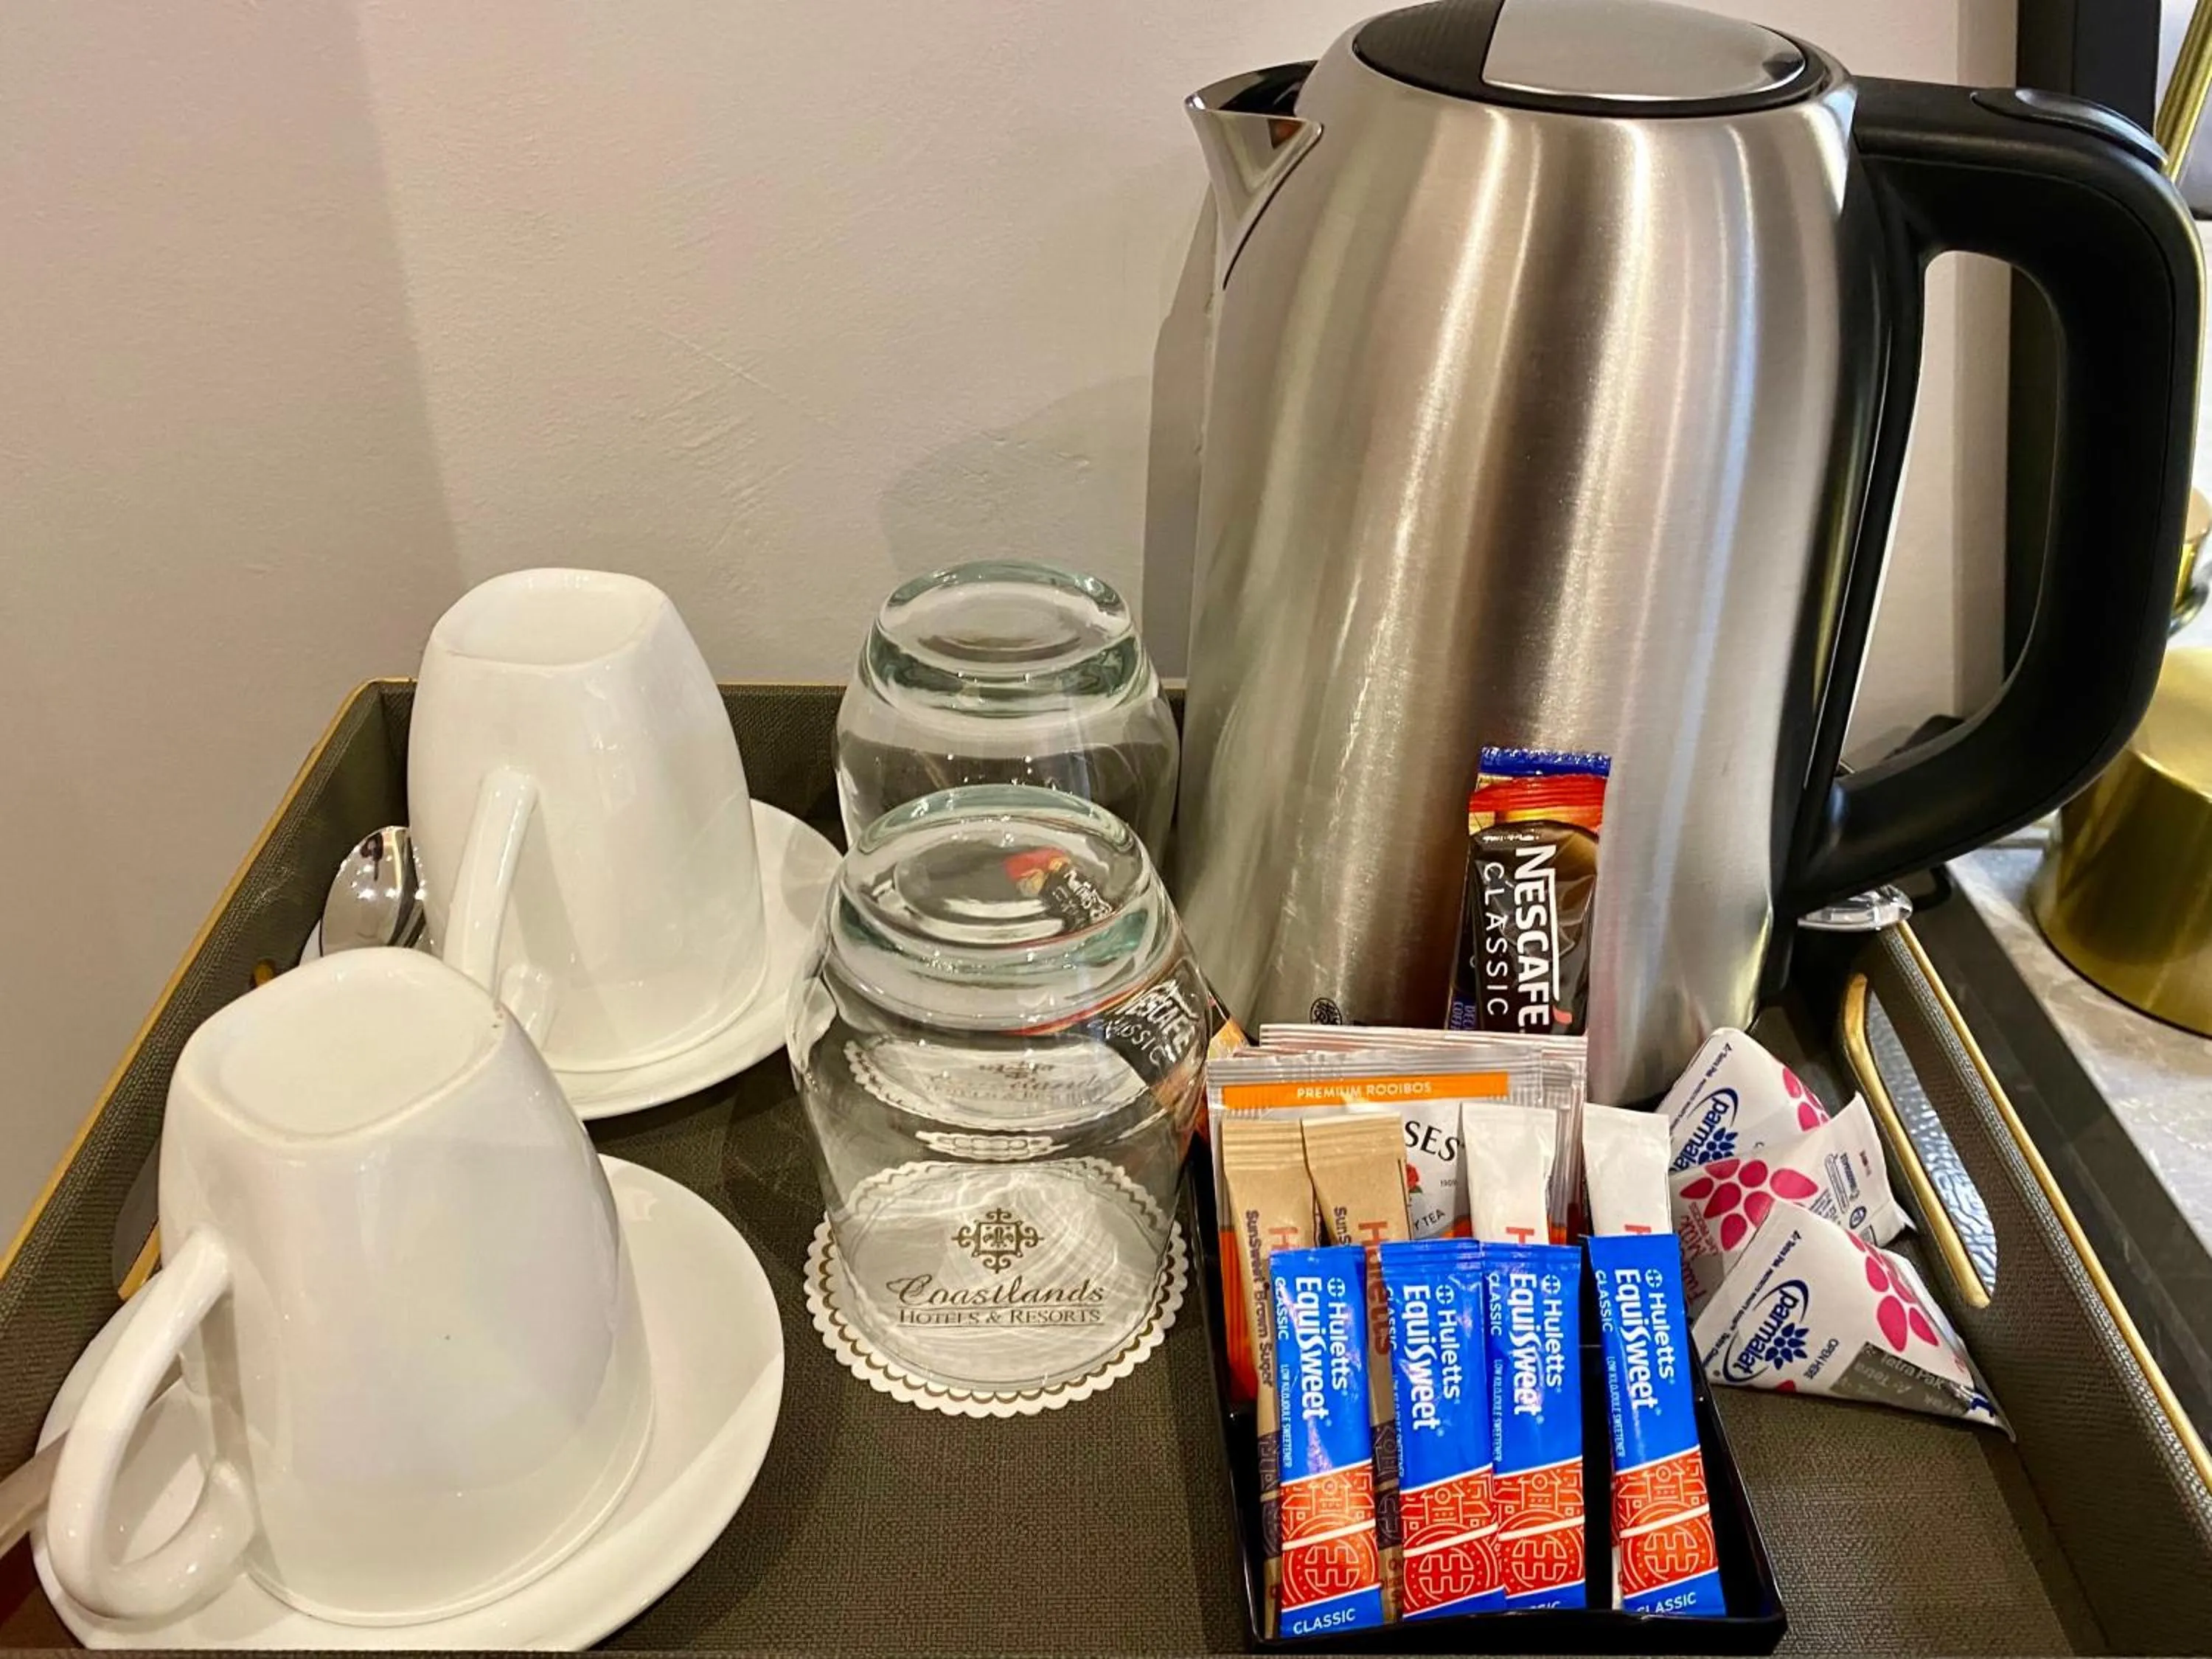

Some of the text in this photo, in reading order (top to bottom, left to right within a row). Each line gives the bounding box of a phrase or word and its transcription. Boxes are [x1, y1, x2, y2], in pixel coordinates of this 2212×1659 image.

[1484, 861, 1509, 1016] CLASSIC
[1297, 1082, 1432, 1099] PREMIUM ROOIBOS
[1405, 1120, 1461, 1162] SES
[1334, 1206, 1352, 1245] SunS
[1422, 1208, 1446, 1226] TEA
[886, 1274, 1104, 1305] Coastlands
[987, 1312, 1001, 1324] &
[1010, 1309, 1101, 1324] RESORTS
[1254, 1290, 1269, 1338] Brown
[1275, 1278, 1289, 1340] CLASSIC
[1487, 1273, 1502, 1336] CLASSIC
[1595, 1270, 1613, 1332] CLASSIC
[1295, 1276, 1328, 1421] EquiSweet
[1328, 1303, 1349, 1391] Huletts
[1402, 1285, 1441, 1430] EquiSweet
[1438, 1310, 1462, 1399] Huletts
[1509, 1273, 1542, 1415] EquiSweet
[1543, 1300, 1565, 1387] Huletts
[1615, 1269, 1658, 1409] EquiSweet
[1649, 1293, 1675, 1379] Huletts
[1733, 1288, 1800, 1374] parmalat
[1258, 1343, 1273, 1388] Sugar
[1293, 1608, 1357, 1635] CLASSIC
